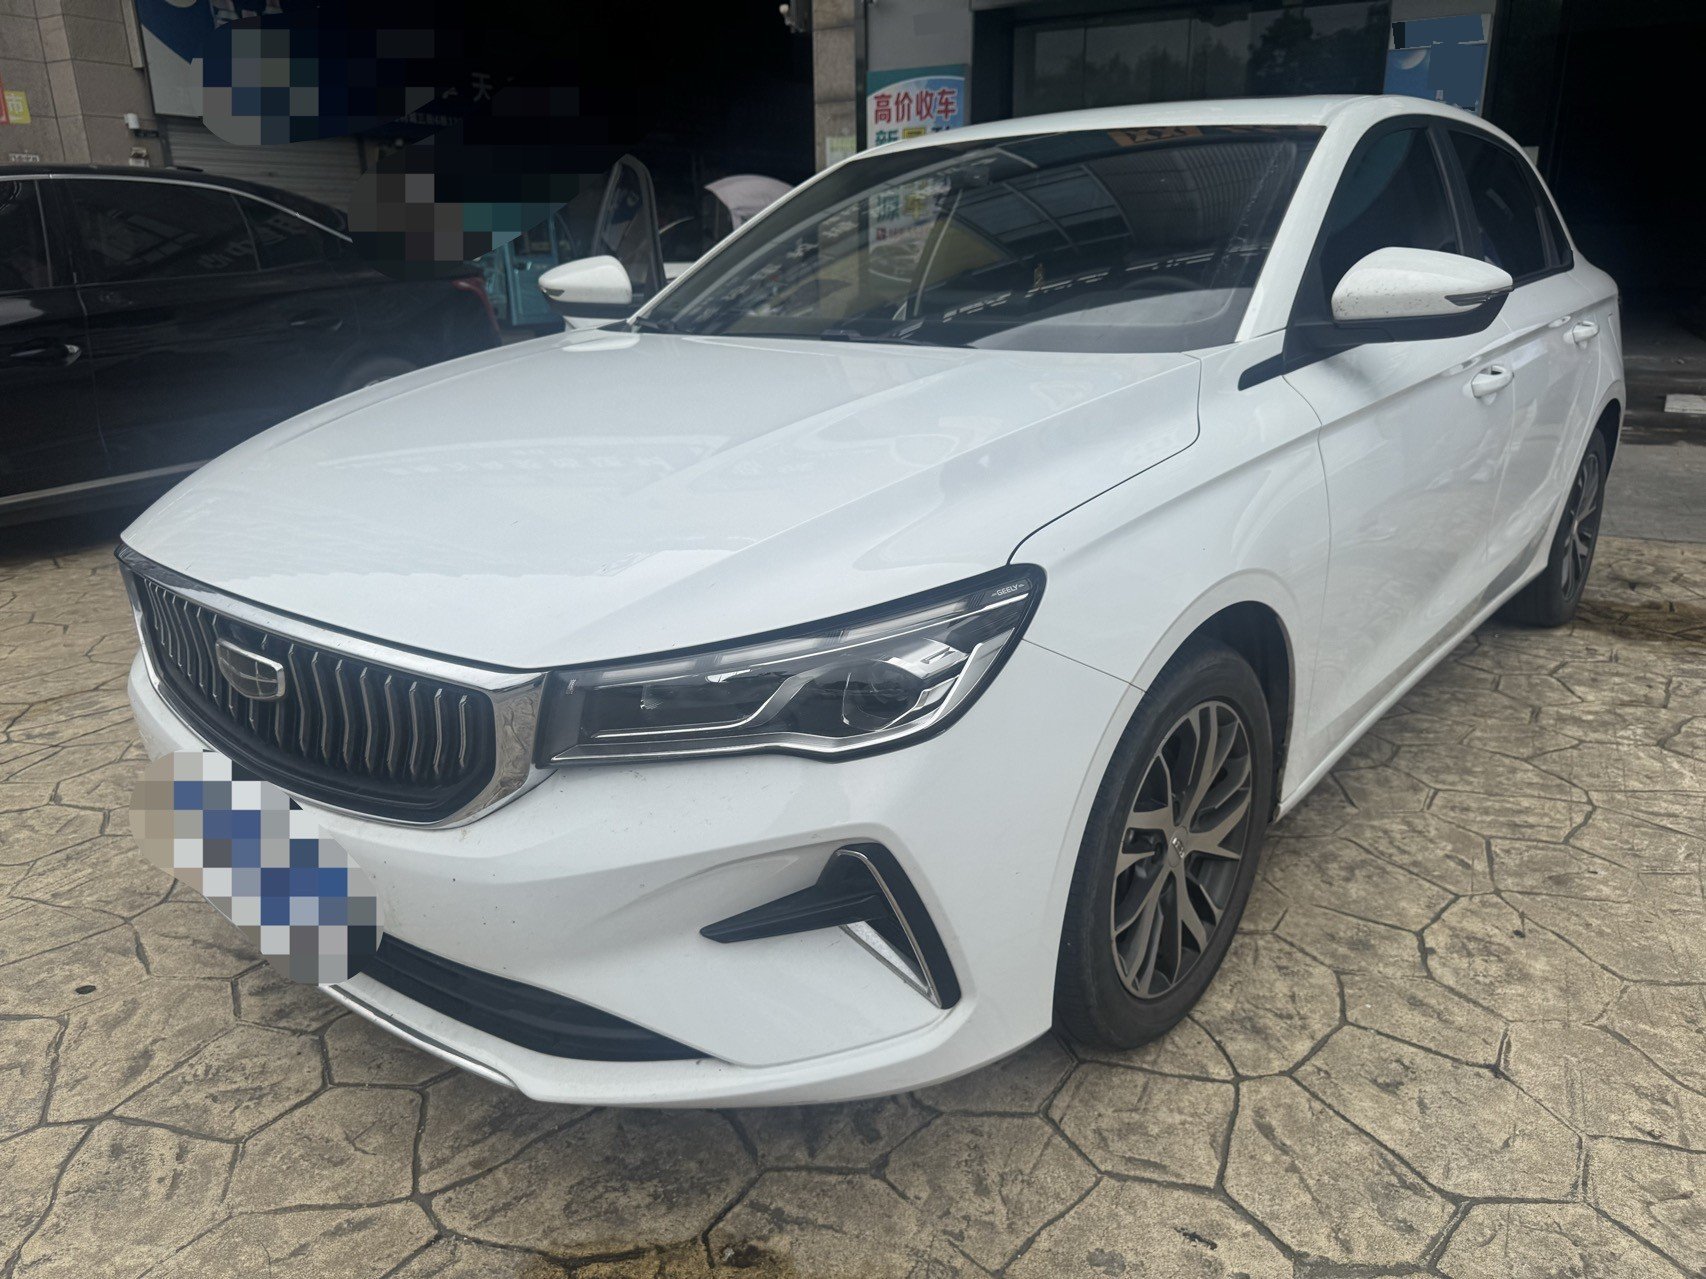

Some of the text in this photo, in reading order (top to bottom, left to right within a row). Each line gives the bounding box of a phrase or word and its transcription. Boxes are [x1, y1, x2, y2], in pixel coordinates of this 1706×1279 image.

[874, 90, 957, 124] 高价收车
[996, 584, 1018, 596] GEELY
